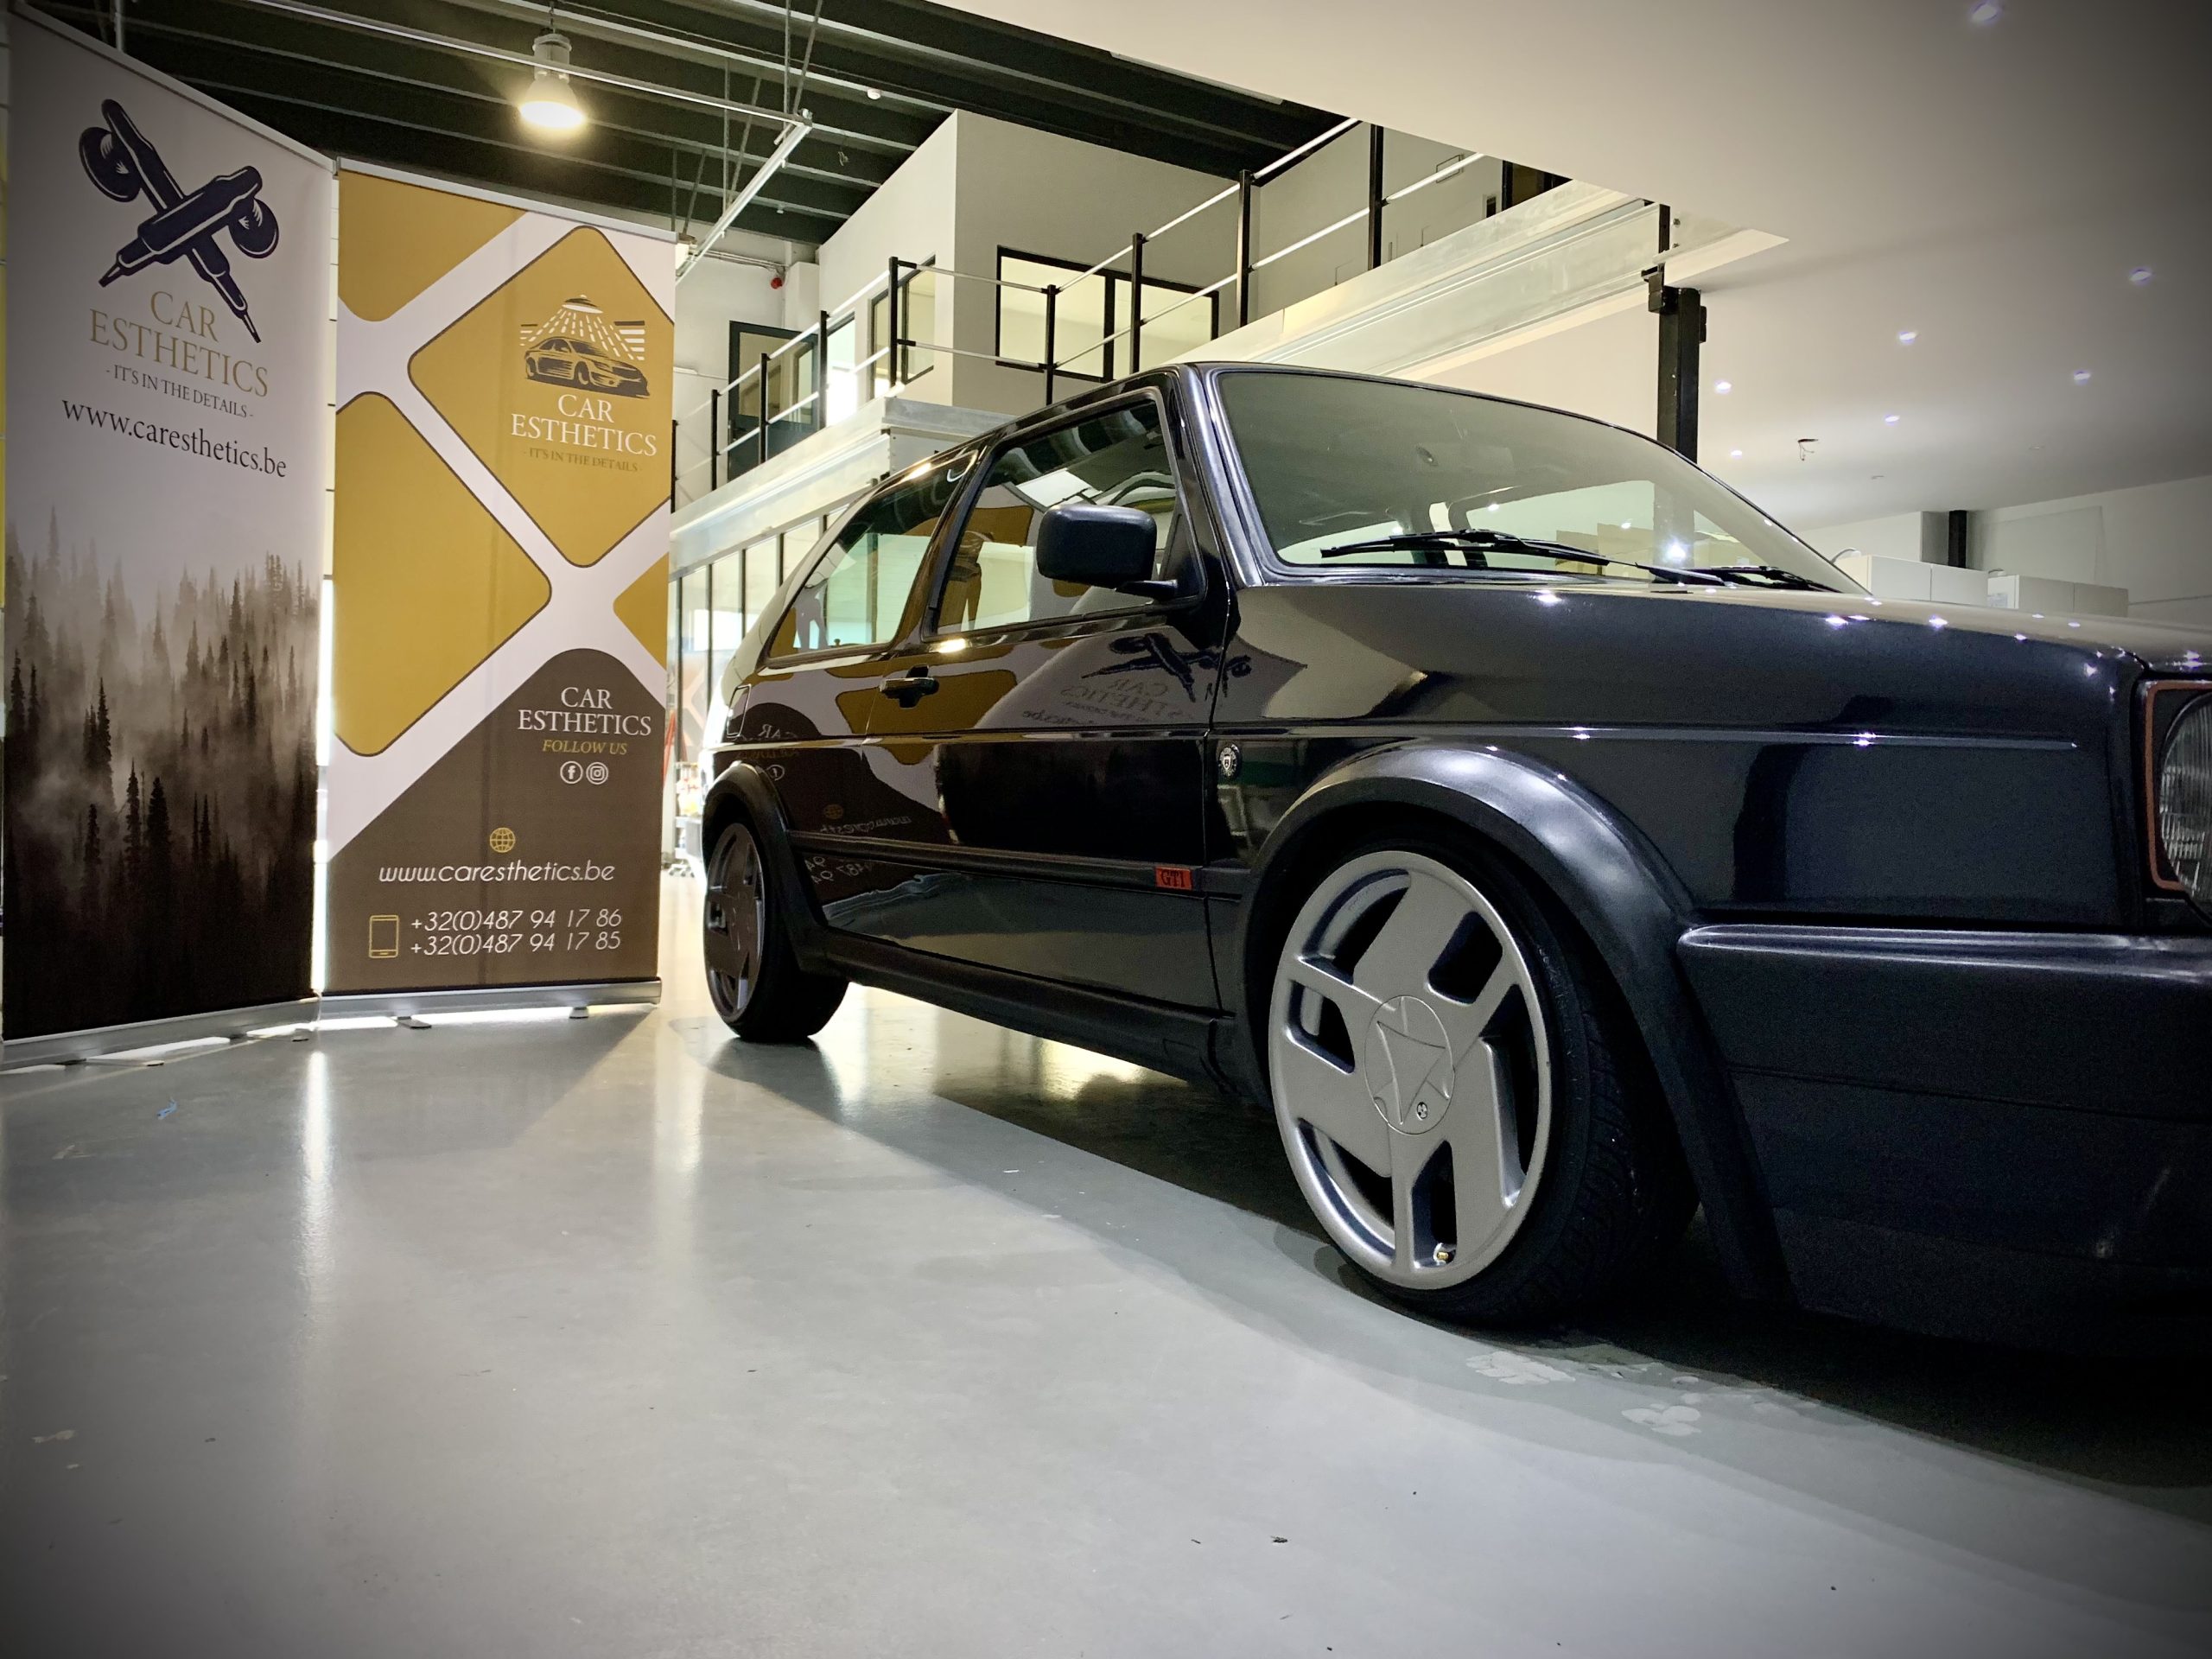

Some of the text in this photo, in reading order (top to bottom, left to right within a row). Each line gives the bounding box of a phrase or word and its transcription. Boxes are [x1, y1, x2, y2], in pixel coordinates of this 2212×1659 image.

[150, 291, 218, 341] CAR
[90, 308, 269, 397] ESTHETICS
[142, 373, 158, 391] IN
[161, 379, 190, 401] THE
[194, 390, 247, 418] DETAILS
[558, 394, 614, 423] CAR
[61, 399, 287, 478] www.caresthetics.be
[511, 413, 657, 456] ESTHETICS
[551, 450, 564, 461] IN
[566, 452, 589, 466] THE
[591, 456, 639, 472] DETAILS
[561, 686, 613, 709] CAR
[518, 709, 652, 736] ESTHETICS
[542, 739, 628, 755] FOLLOW US
[378, 859, 615, 882] www.caresthetics.be
[1160, 869, 1185, 888] GTI
[410, 908, 622, 931] +32(0)487 94 17 86
[410, 931, 621, 956] +32(0)487 94 17 85
